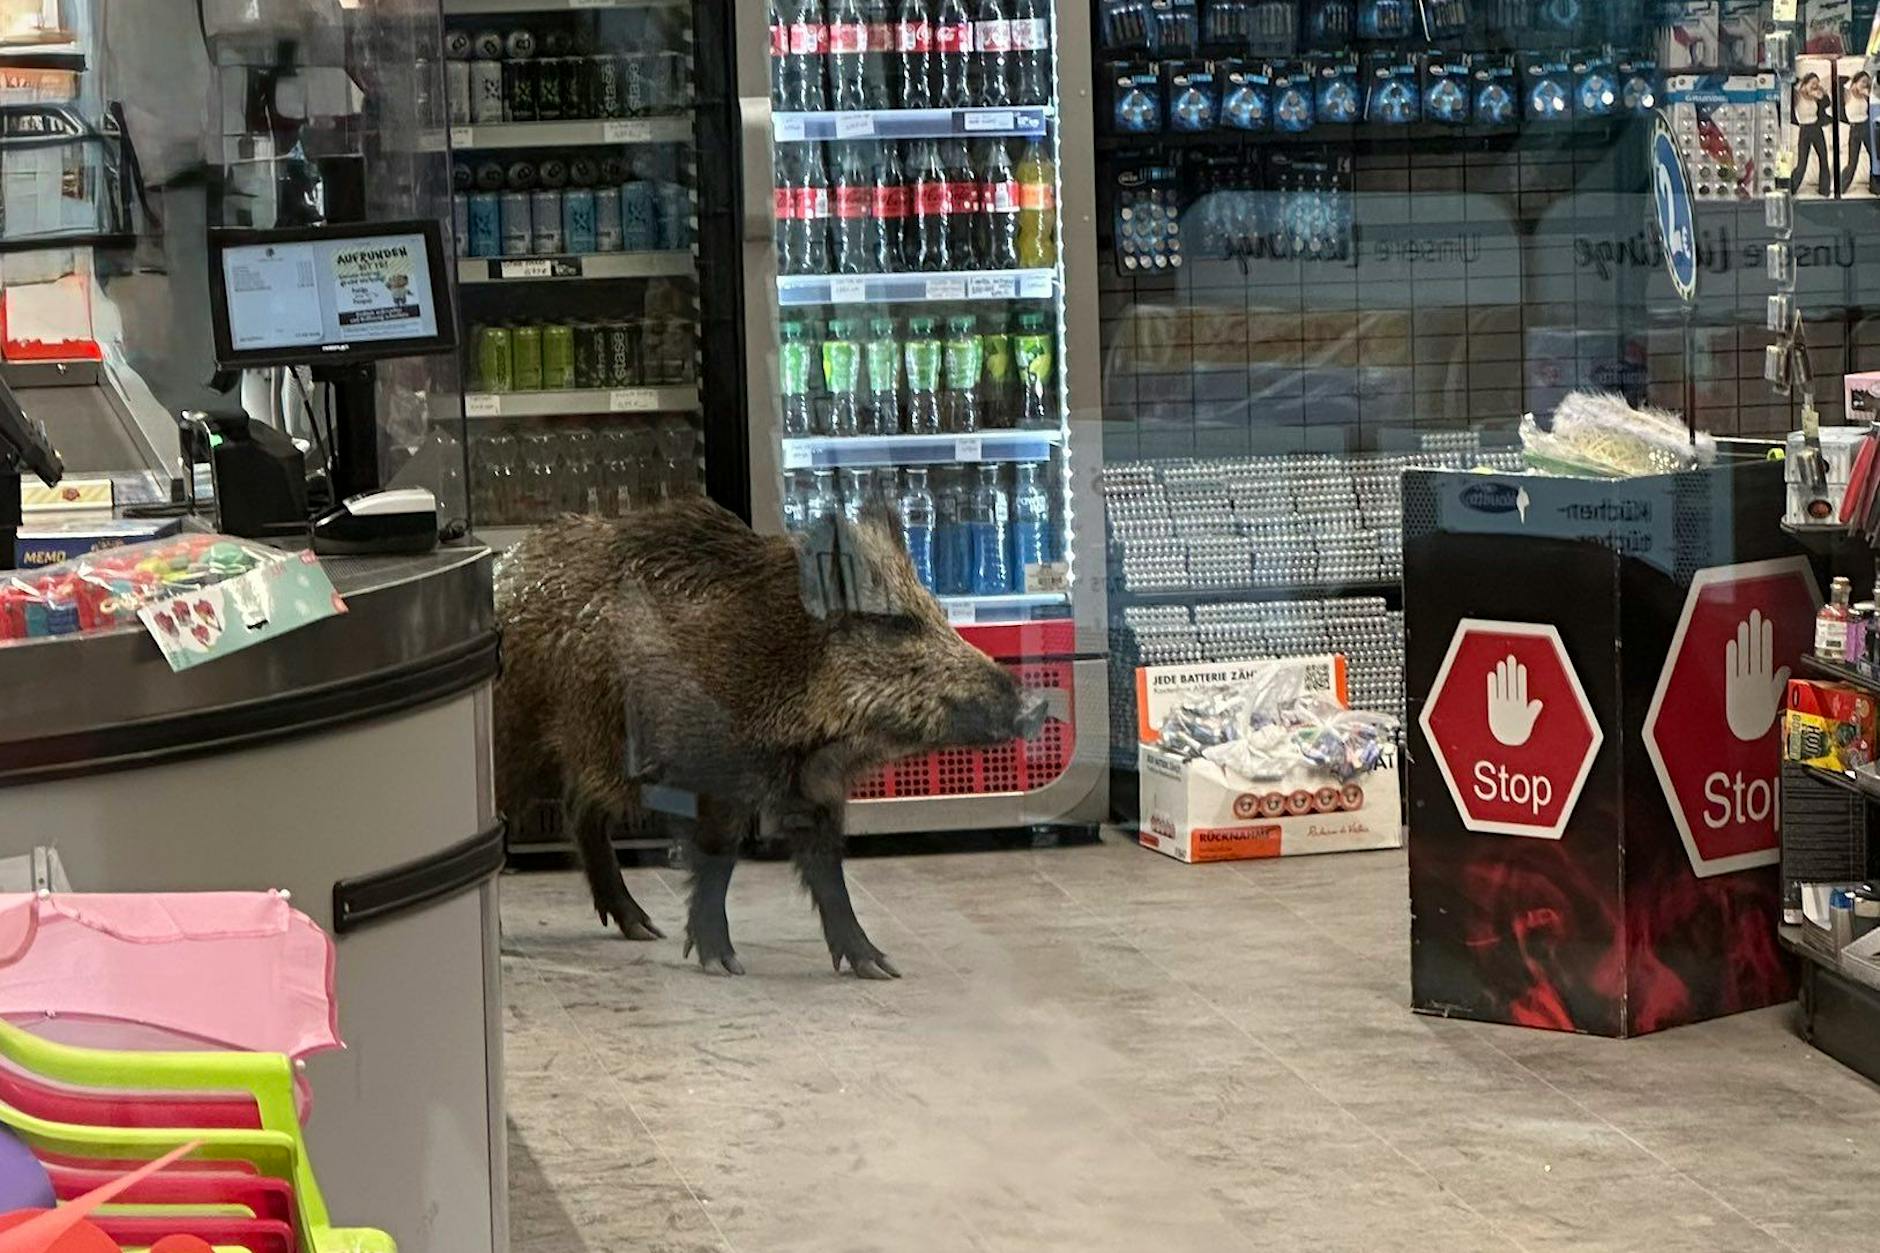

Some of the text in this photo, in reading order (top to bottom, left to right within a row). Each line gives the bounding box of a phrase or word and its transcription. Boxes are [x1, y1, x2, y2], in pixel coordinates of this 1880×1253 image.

[337, 246, 408, 264] AUFRUNDEN
[23, 551, 66, 565] MEMO
[1153, 668, 1257, 686] JEDE BATTERIE ZÄH
[1473, 760, 1552, 815] Stop
